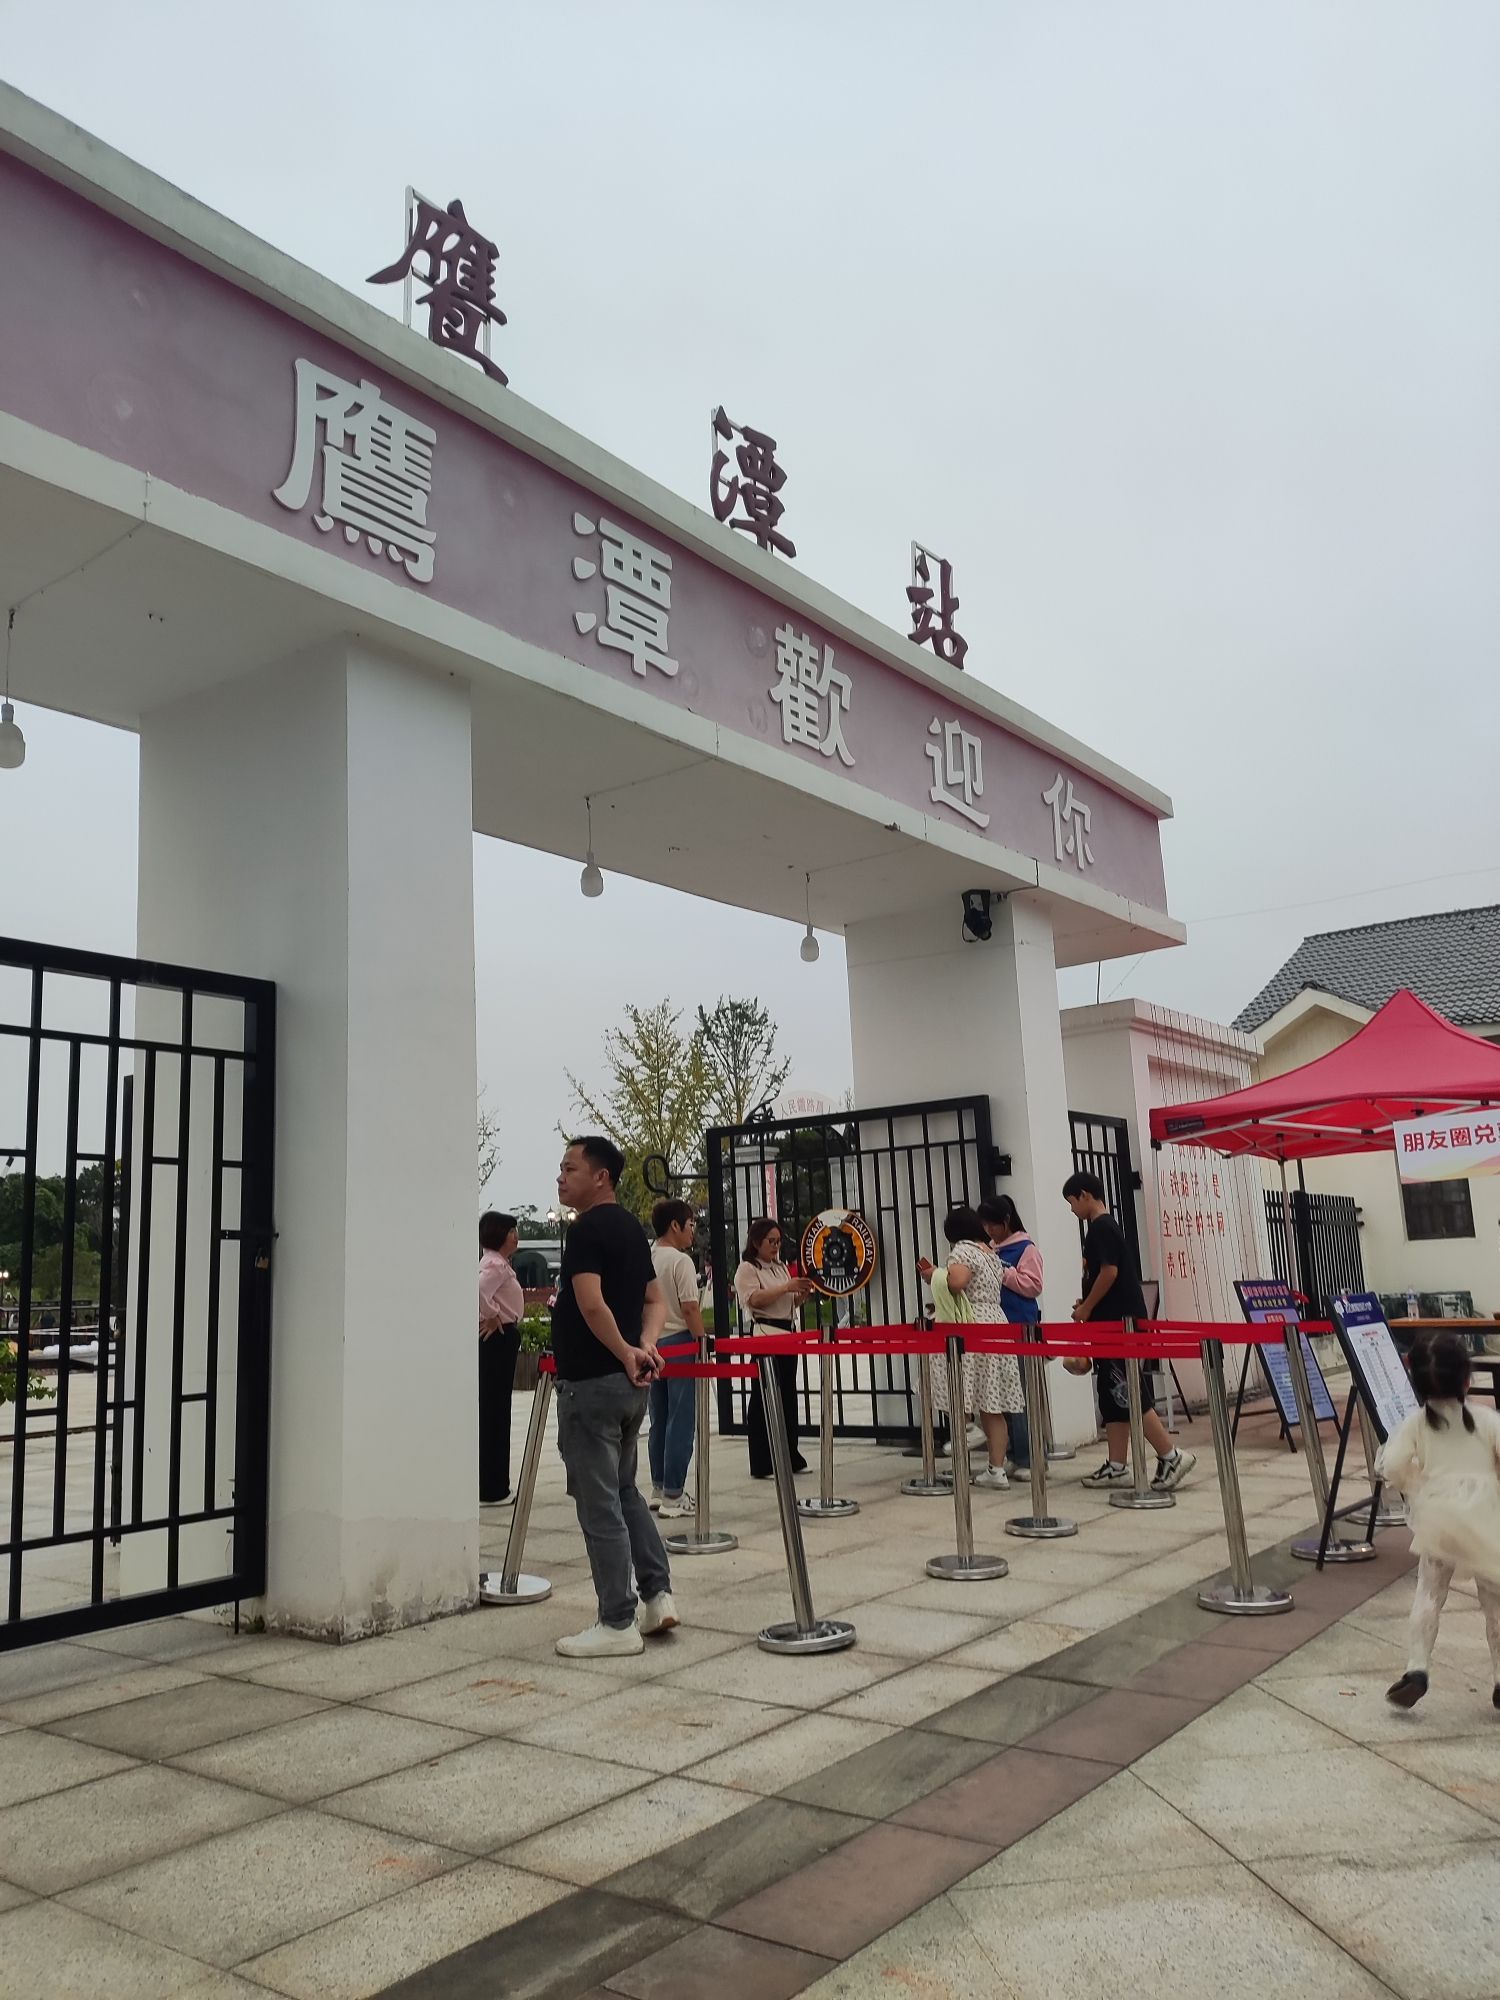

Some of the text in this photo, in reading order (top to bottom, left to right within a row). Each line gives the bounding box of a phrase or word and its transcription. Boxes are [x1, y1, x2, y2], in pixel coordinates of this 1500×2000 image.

[271, 357, 1095, 871] 鷹潭歡迎你
[1403, 1123, 1500, 1153] 朋友圈兑
[851, 1217, 874, 1264] RAILWAY
